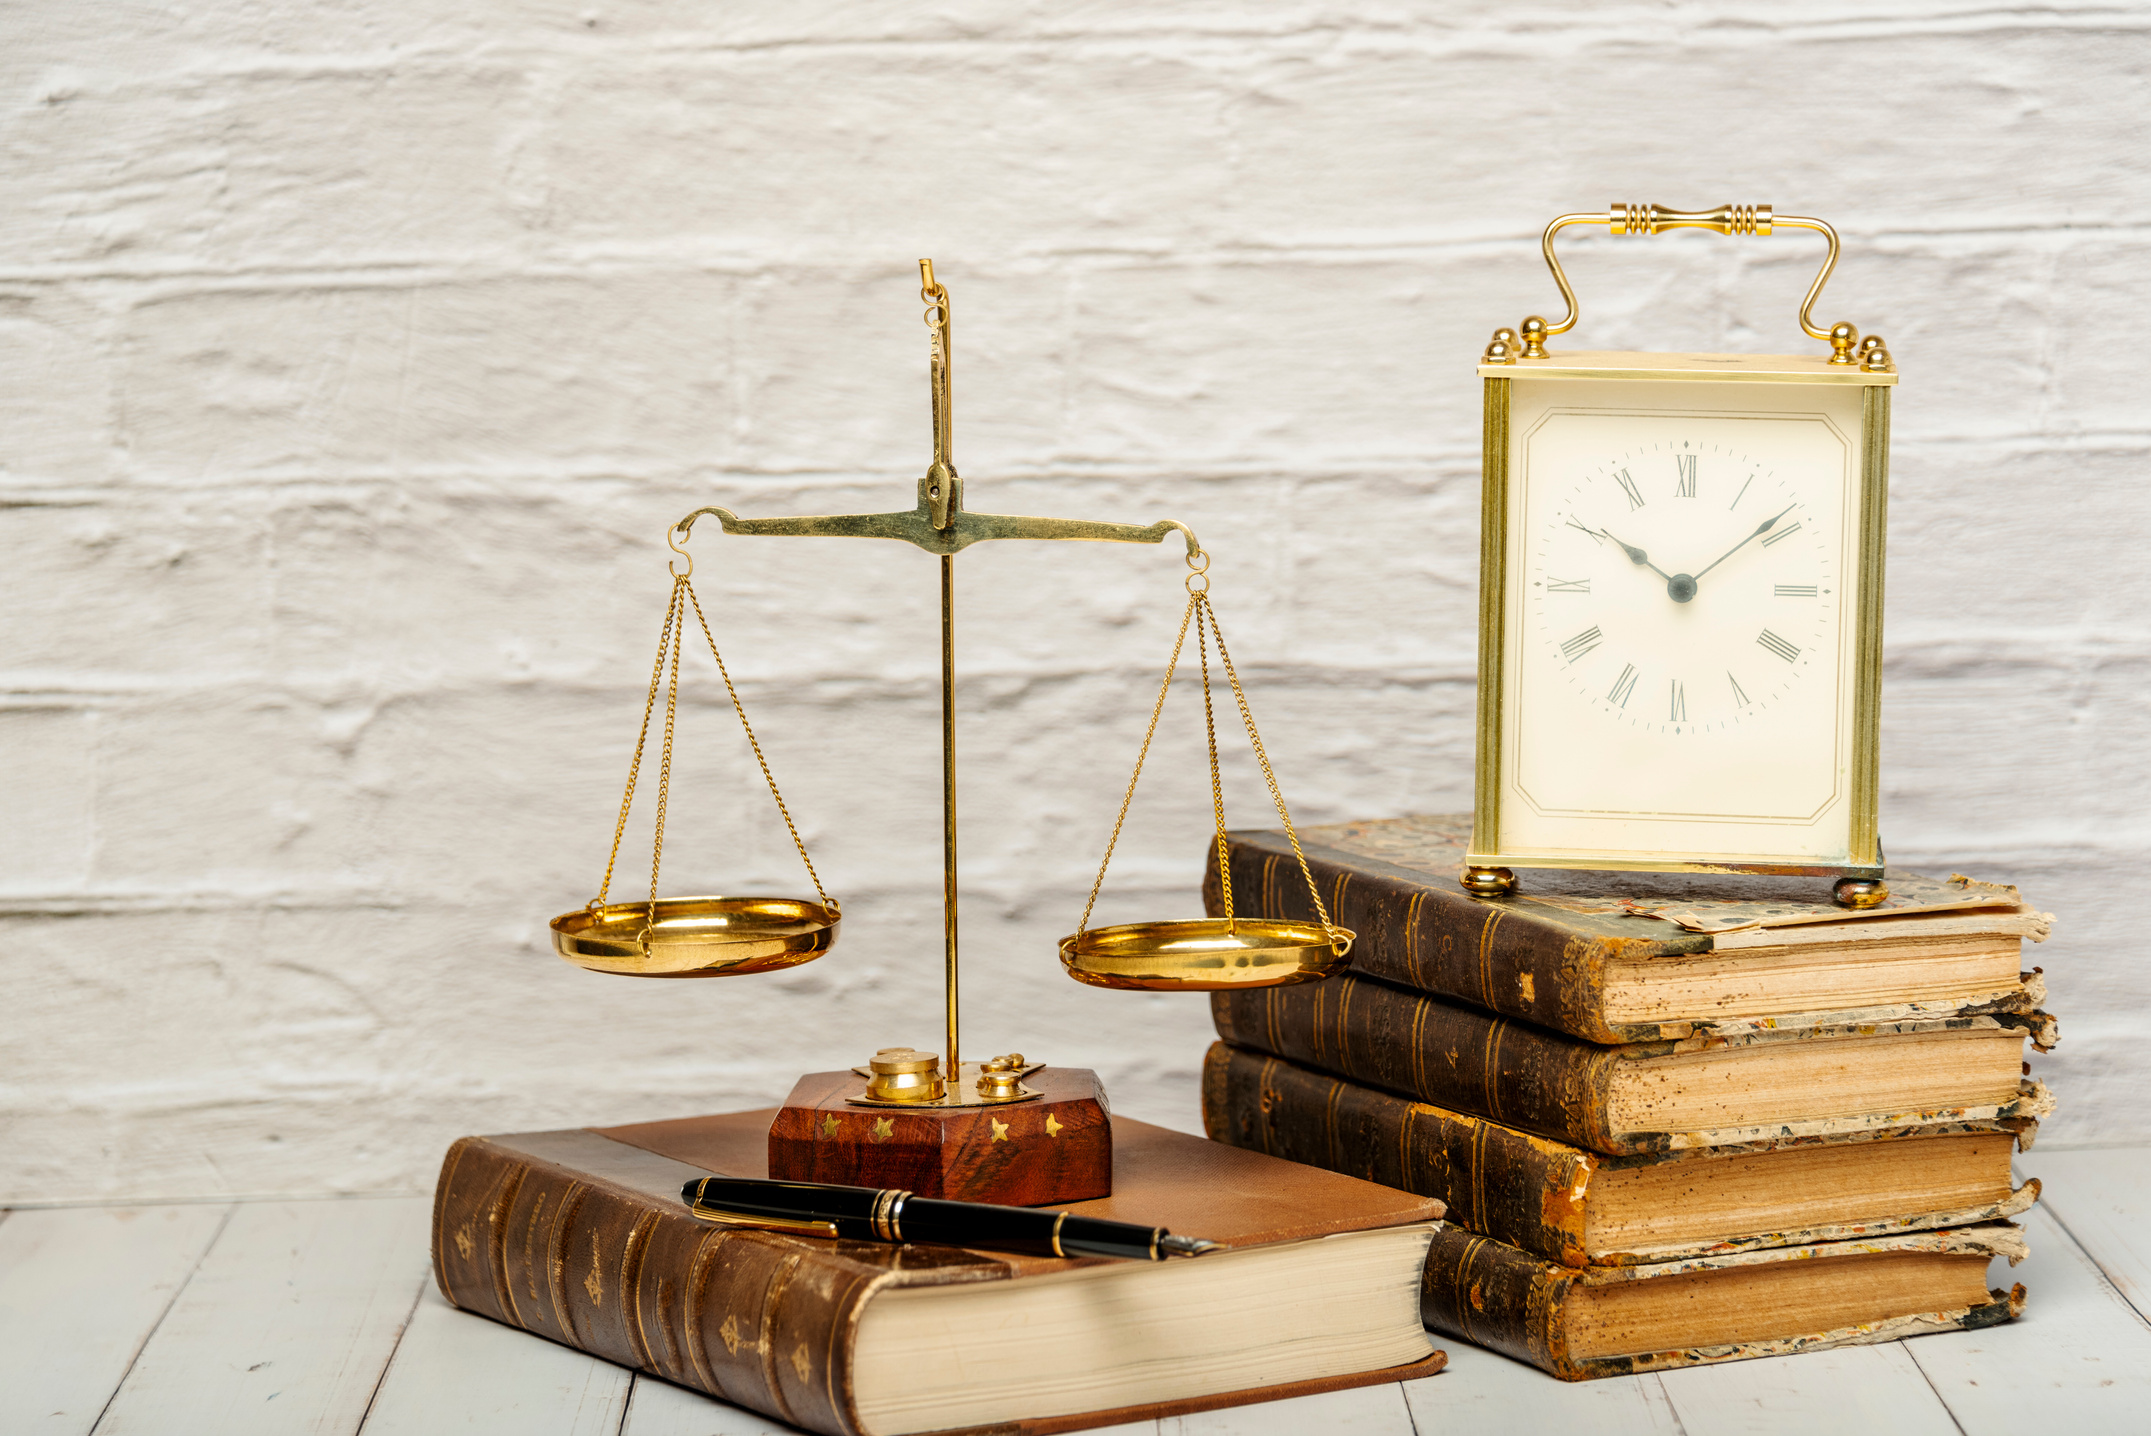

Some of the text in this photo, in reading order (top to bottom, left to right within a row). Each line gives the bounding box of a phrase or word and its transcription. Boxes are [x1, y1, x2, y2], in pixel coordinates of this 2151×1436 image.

[1612, 467, 1646, 512] XI
[1673, 454, 1698, 499] XII
[1565, 513, 1608, 546] X
[1760, 520, 1803, 549] II
[1547, 576, 1591, 595] IX
[1773, 584, 1818, 598] III
[1560, 624, 1604, 665] VIII
[1755, 627, 1802, 665] IIII
[1606, 662, 1641, 709] VII
[1669, 678, 1688, 722] VI
[1726, 669, 1752, 709] V
